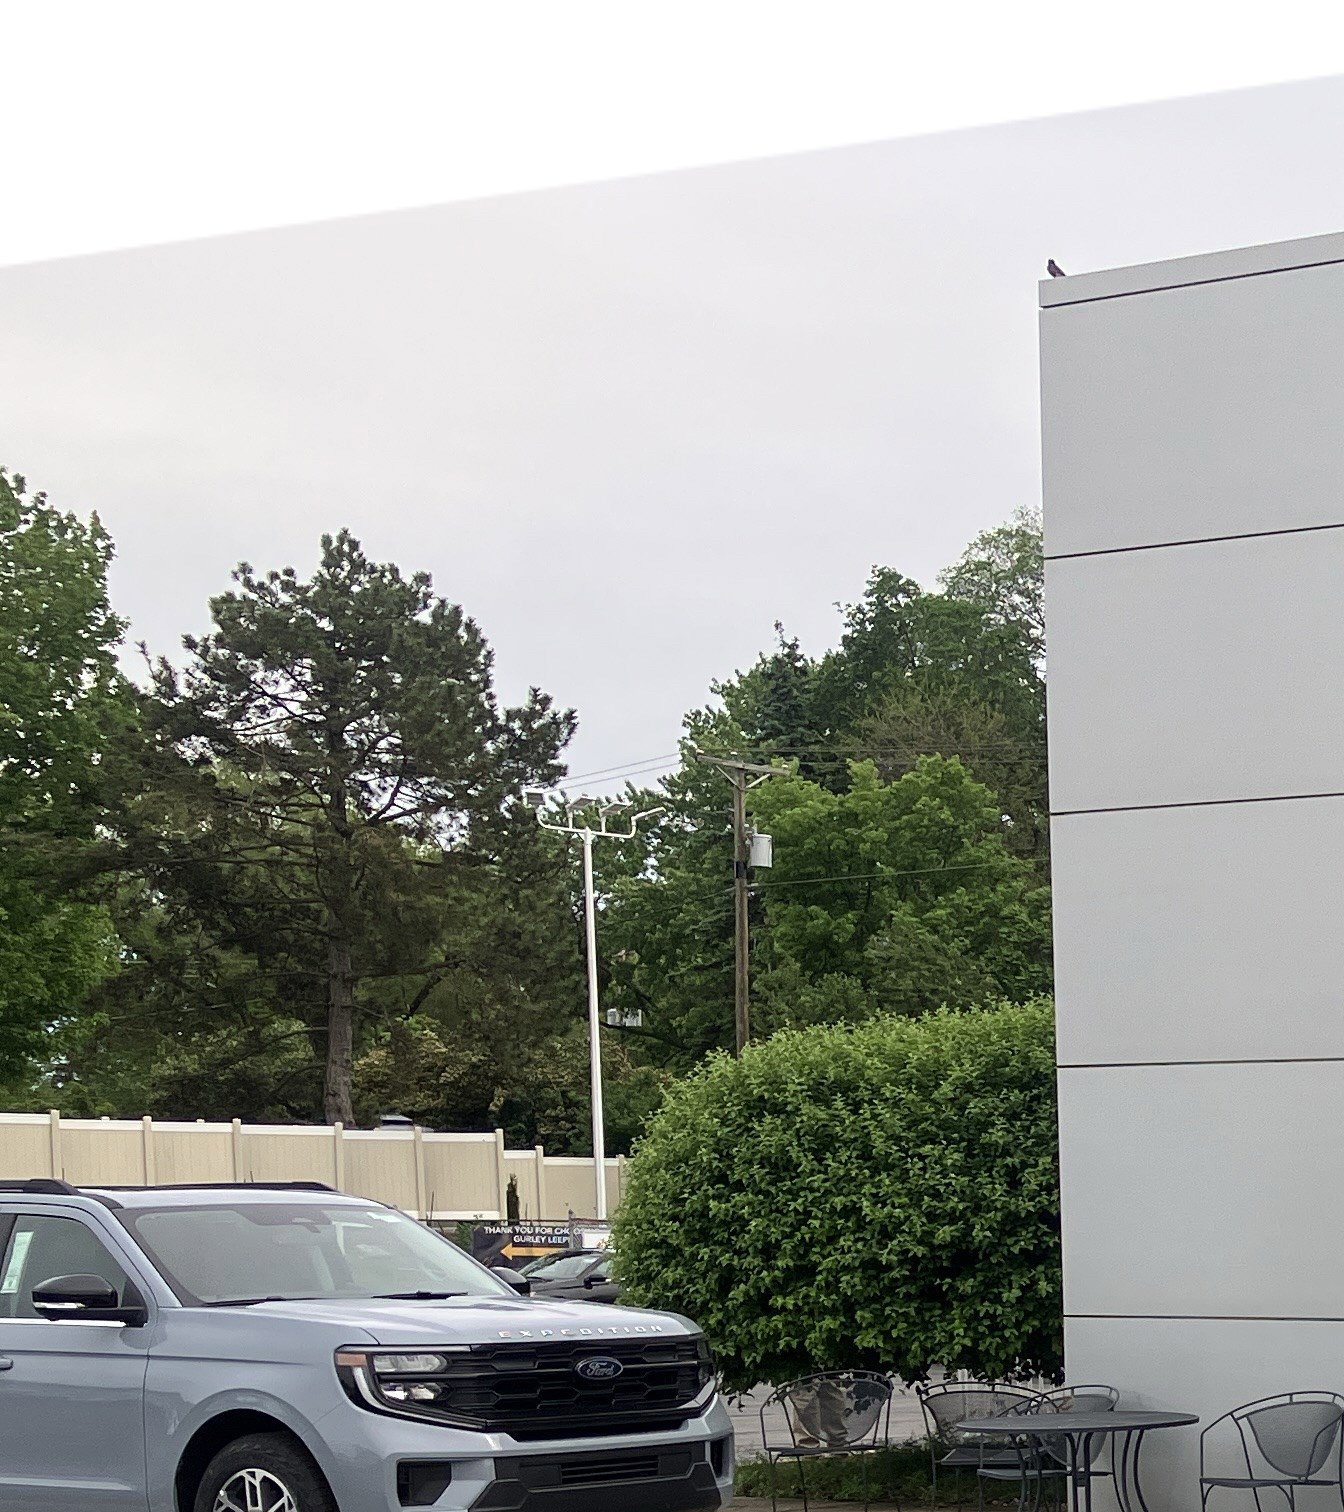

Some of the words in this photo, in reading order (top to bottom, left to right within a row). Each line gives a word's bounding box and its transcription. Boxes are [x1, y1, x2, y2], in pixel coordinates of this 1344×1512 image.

[483, 1226, 513, 1235] THANK
[514, 1226, 534, 1235] YOU
[535, 1226, 553, 1235] FOR
[513, 1235, 546, 1244] GURLEY
[498, 1324, 663, 1339] EXPEDITION
[586, 1361, 615, 1377] Ford
